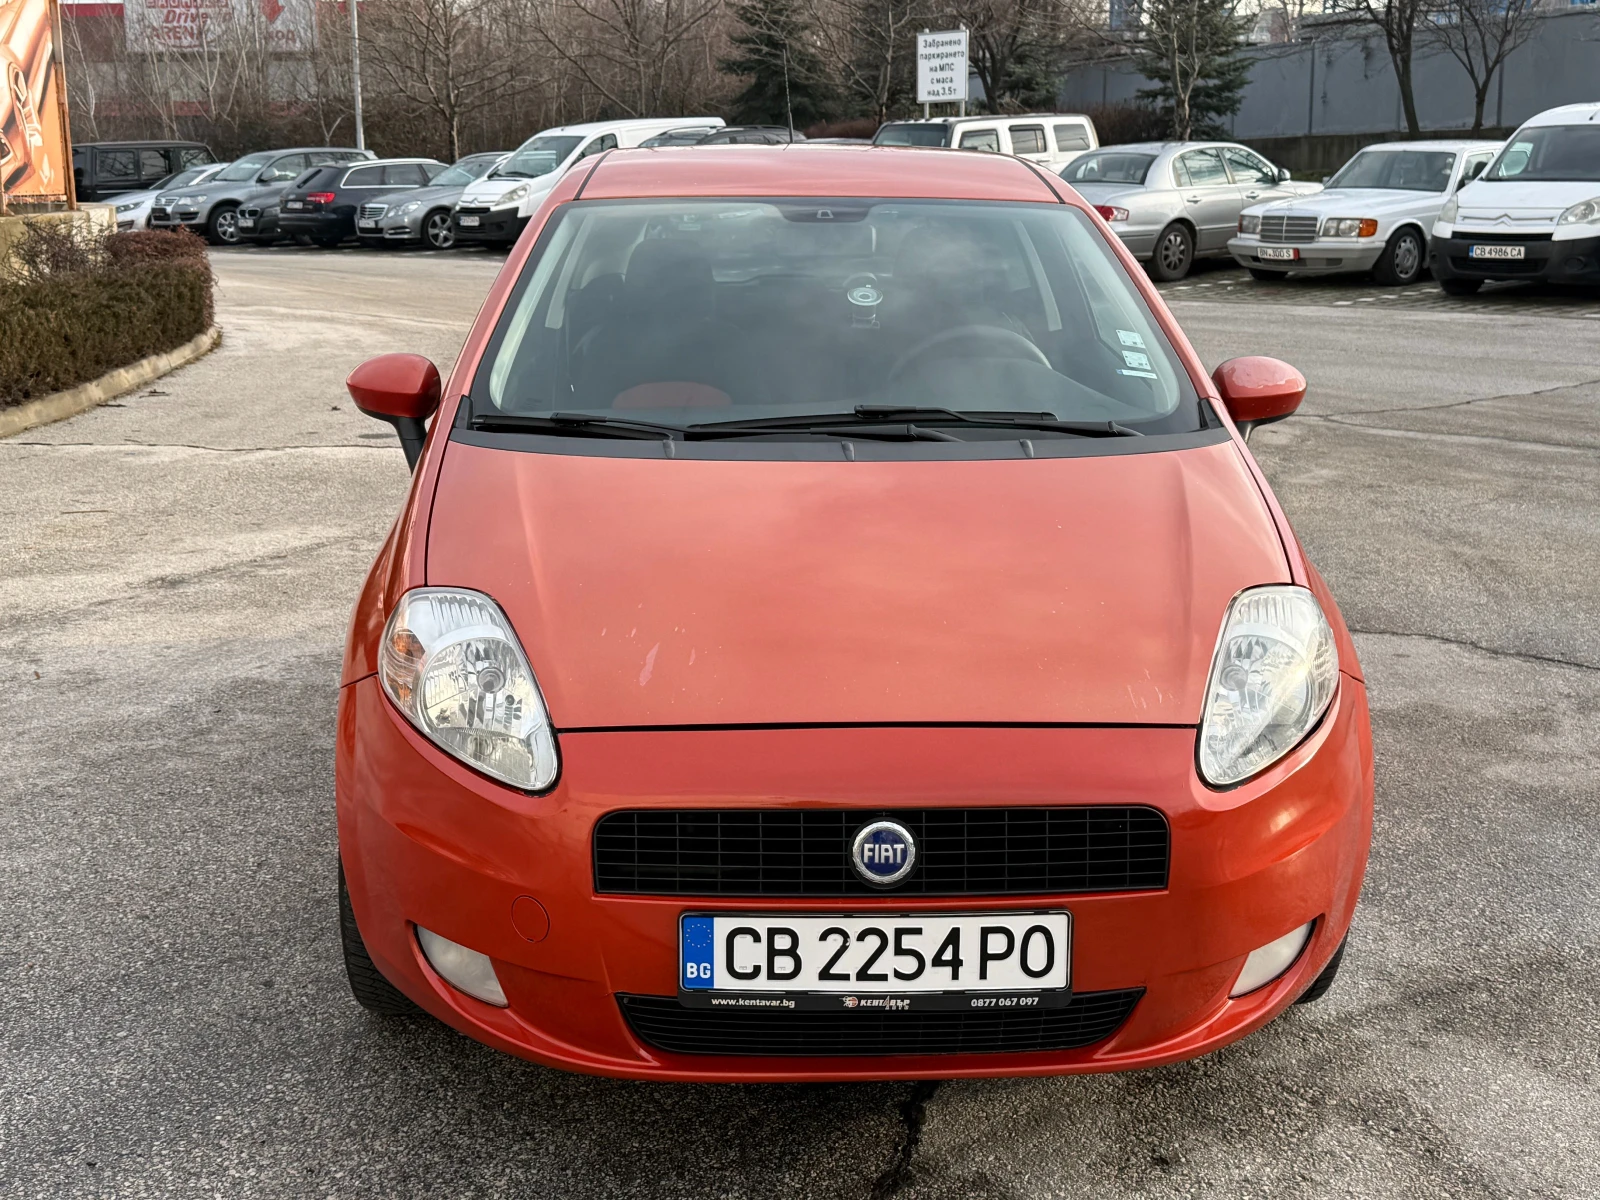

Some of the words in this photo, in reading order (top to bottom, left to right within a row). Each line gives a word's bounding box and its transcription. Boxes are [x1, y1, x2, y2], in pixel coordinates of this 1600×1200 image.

[923, 39, 962, 49] Забранено
[919, 50, 965, 61] паркирането
[939, 62, 955, 72] МПС
[936, 76, 953, 84] маса
[927, 89, 940, 97] над
[1474, 247, 1486, 257] CB
[1487, 247, 1509, 257] 4986
[1510, 247, 1522, 257] CA
[864, 843, 905, 864] FIAT
[726, 927, 802, 980] CB
[818, 926, 963, 981] 2254
[979, 924, 1055, 980] PO
[686, 962, 711, 979] BG
[711, 998, 796, 1009] www.kentavar.bg
[970, 998, 997, 1007] 0877
[998, 998, 1018, 1006] 067
[1019, 997, 1039, 1006] 097
